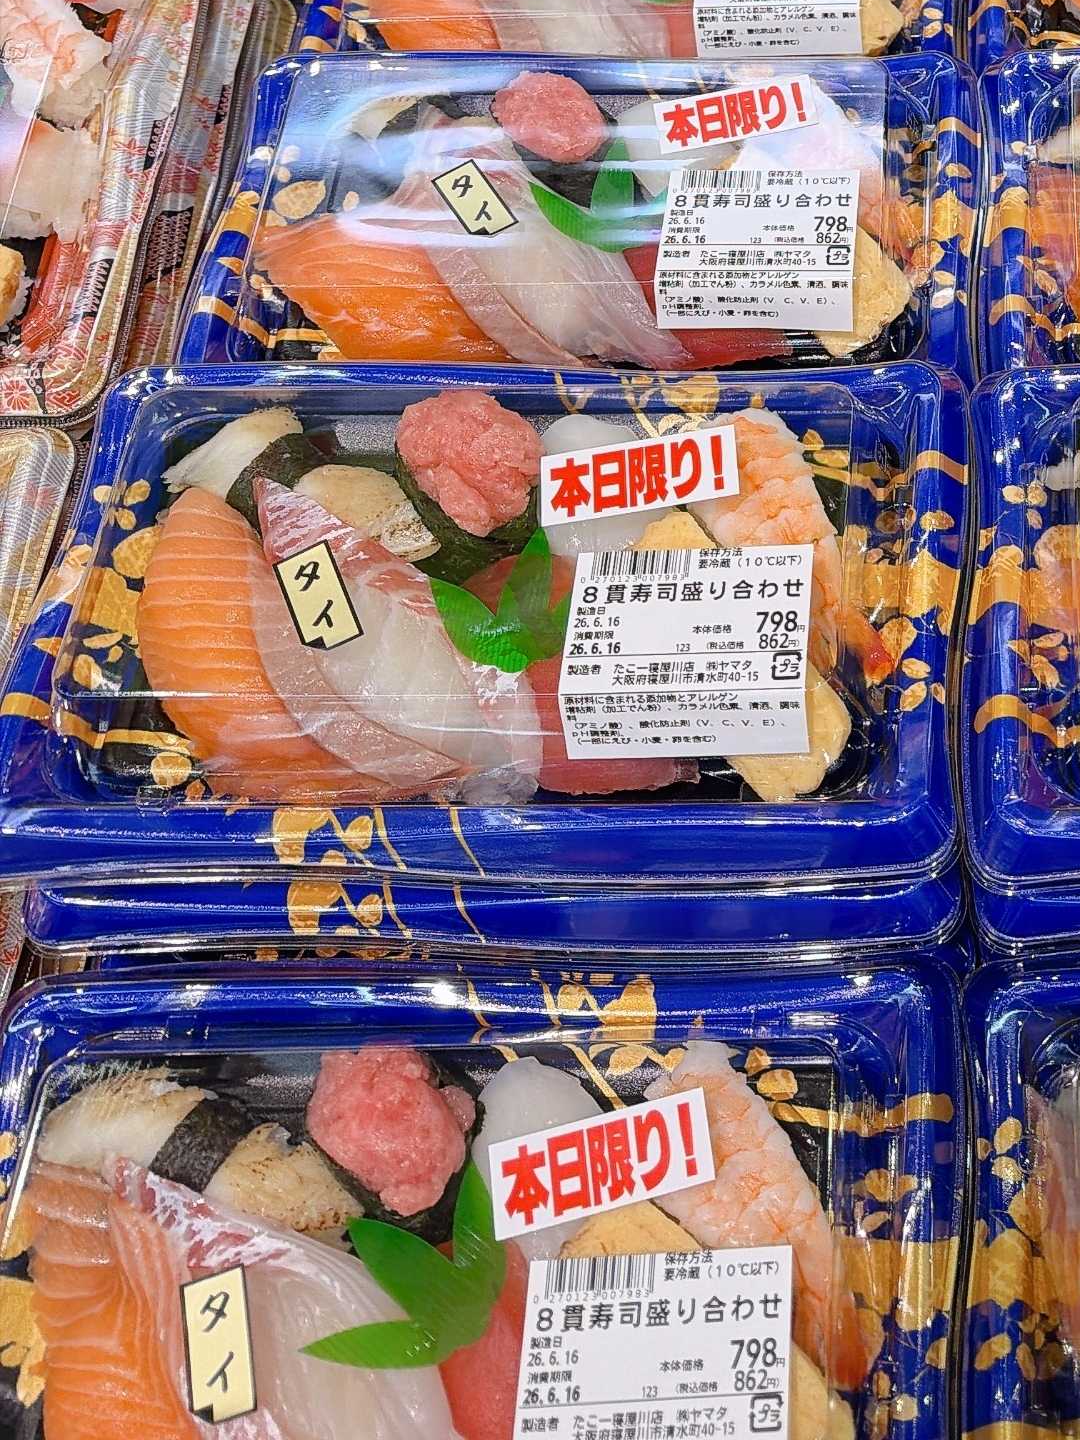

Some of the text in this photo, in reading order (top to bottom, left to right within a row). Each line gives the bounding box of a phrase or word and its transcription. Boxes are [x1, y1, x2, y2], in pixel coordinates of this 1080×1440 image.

[663, 82, 806, 145] 本日限り!
[451, 174, 493, 223] タイ
[675, 194, 852, 208] 8貫寿司盛り合わせ
[550, 433, 725, 517] 本日限り!
[294, 561, 336, 630] タイ
[583, 579, 803, 604] 8貫寿司盛り合わせ
[577, 607, 606, 615] 製造日
[574, 617, 620, 628] 26.6.16
[692, 625, 732, 634] 本体価格
[574, 631, 614, 640] 消費期限
[569, 643, 620, 655] 26.6.16
[676, 644, 690, 652] 123
[567, 664, 602, 675] 製造者
[501, 1102, 701, 1224] 本日限り!
[536, 1293, 782, 1332] 8貫寿司盛り合わせ
[198, 1290, 232, 1391] タイ
[530, 1336, 562, 1348] 製造日
[527, 1350, 579, 1367] 26.6.16
[660, 1360, 704, 1372] 本体価格
[527, 1371, 572, 1384] 消費期限
[523, 1386, 580, 1405] 26.6.16
[642, 1386, 658, 1398] 123
[521, 1418, 559, 1433] 製造者
